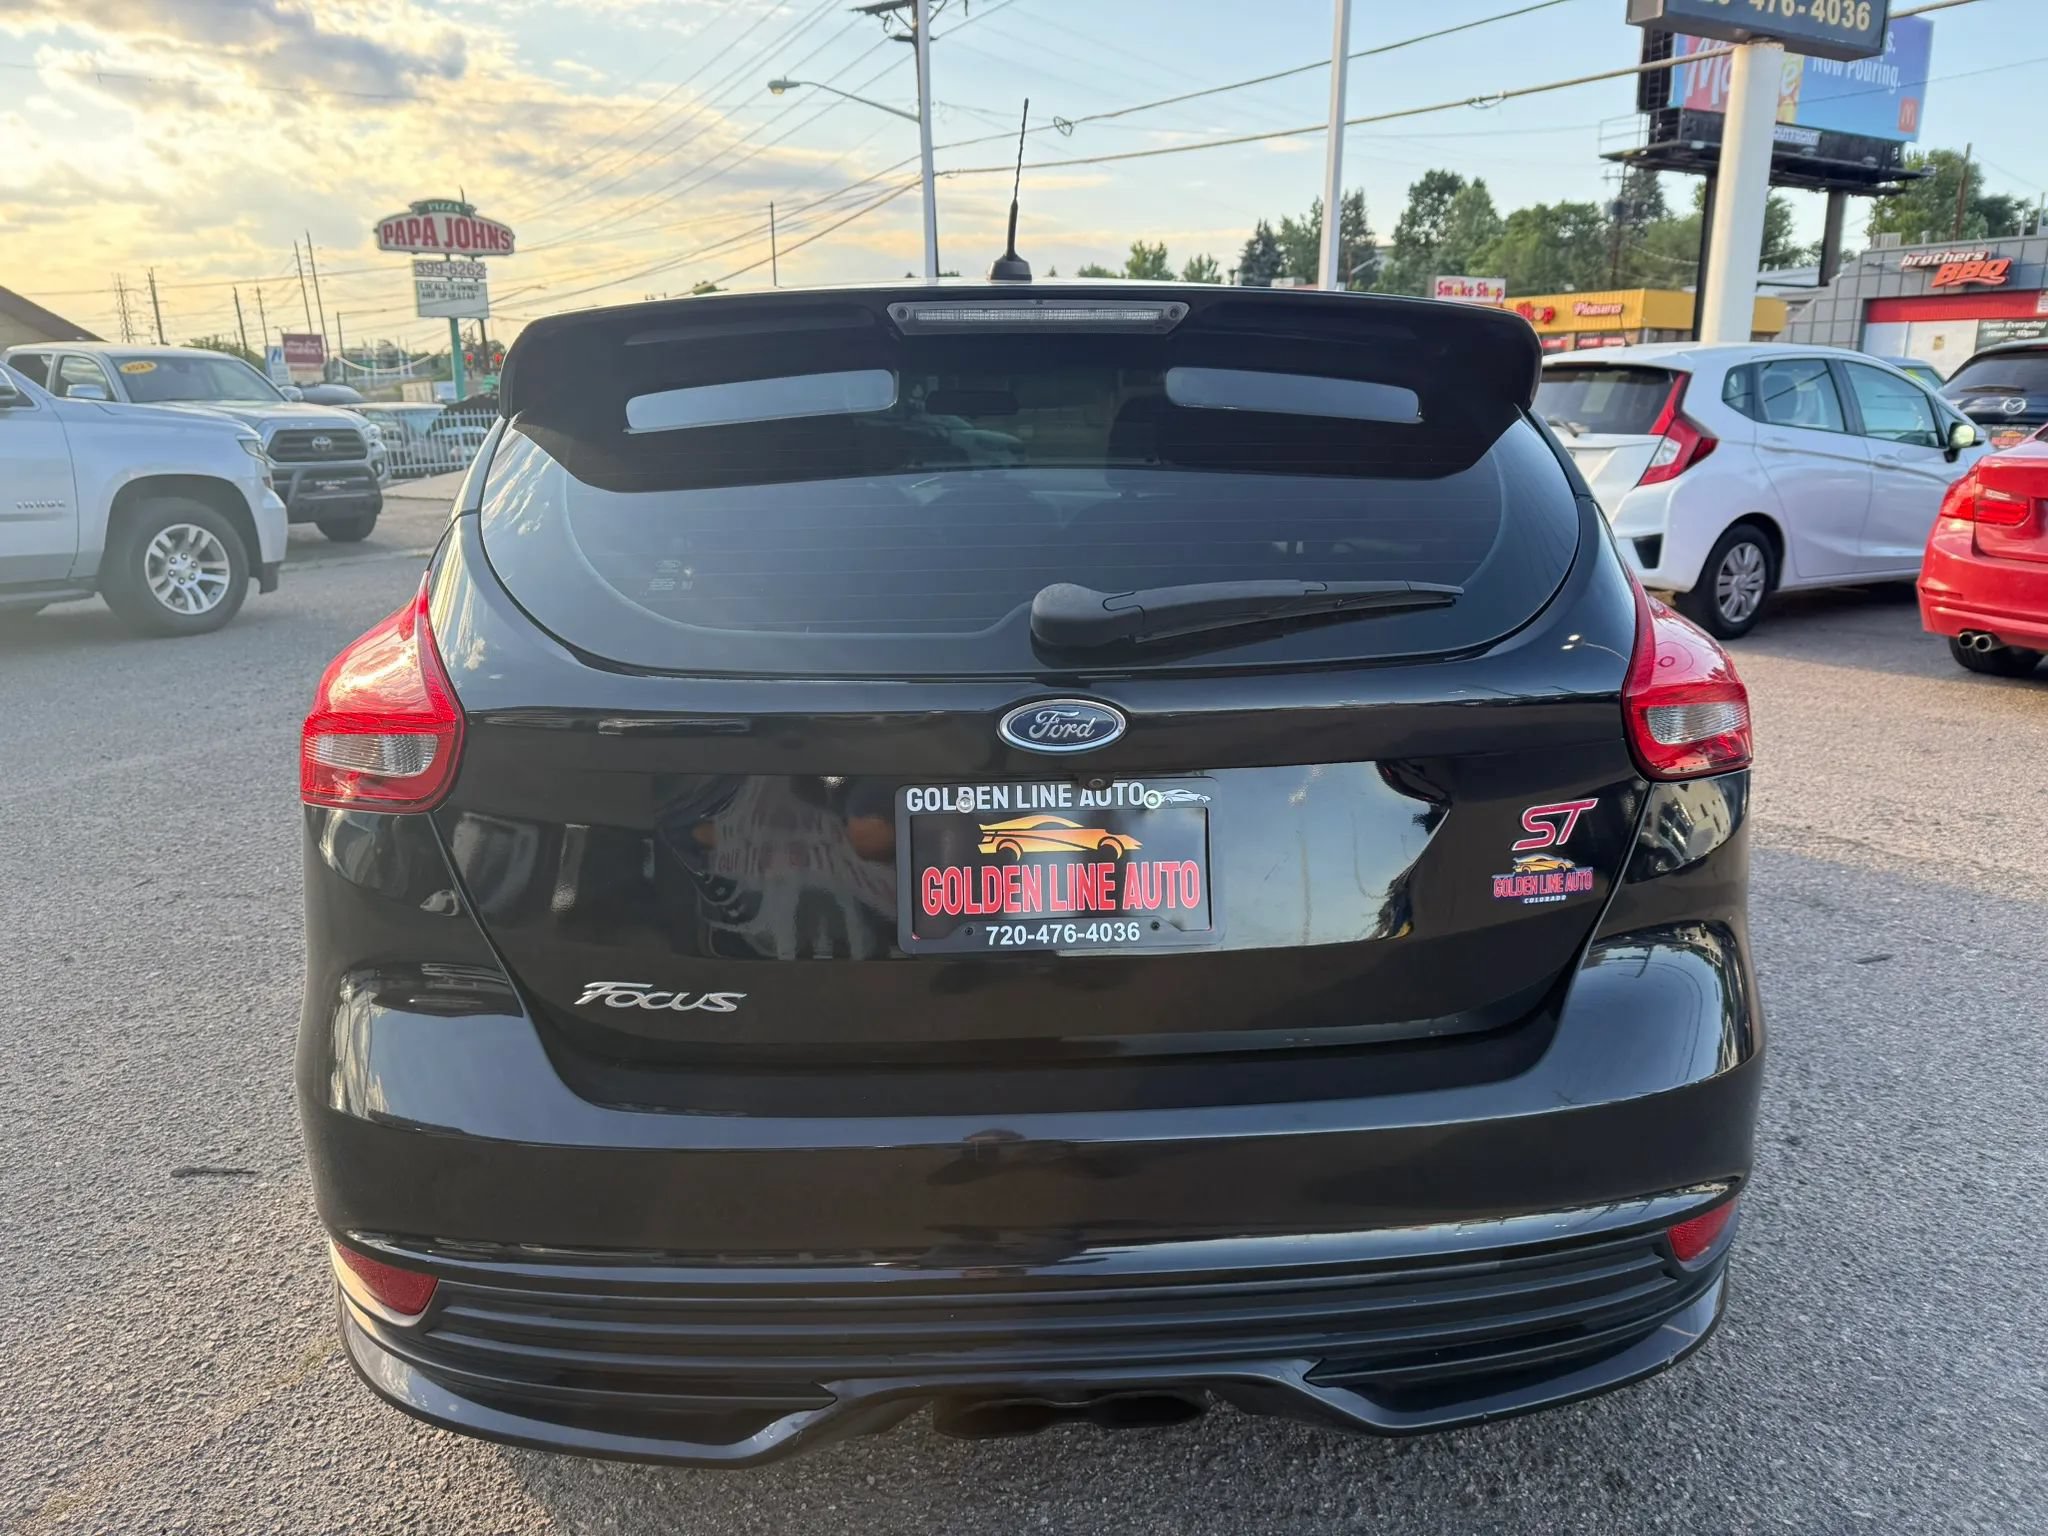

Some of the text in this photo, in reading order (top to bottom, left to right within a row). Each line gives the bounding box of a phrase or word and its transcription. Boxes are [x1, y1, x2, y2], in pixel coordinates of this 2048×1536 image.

[427, 202, 461, 212] PIZZA
[383, 216, 511, 250] PAPA JOHNS
[416, 262, 485, 277] 399-6262
[1901, 251, 1987, 267] brothers
[1931, 257, 2013, 288] BBQ
[1438, 281, 1504, 304] Smoke Shop
[1028, 710, 1097, 739] Ford
[1016, 783, 1074, 808] LINE
[1079, 781, 1146, 807] AUTO
[1511, 797, 1599, 851] ST
[921, 860, 1201, 916] GOLDEN LINE AUTO
[1493, 871, 1593, 898] GOLDEN LINE AUTO
[1523, 895, 1567, 904] COLORADO
[985, 922, 1141, 945] 720-476-4036
